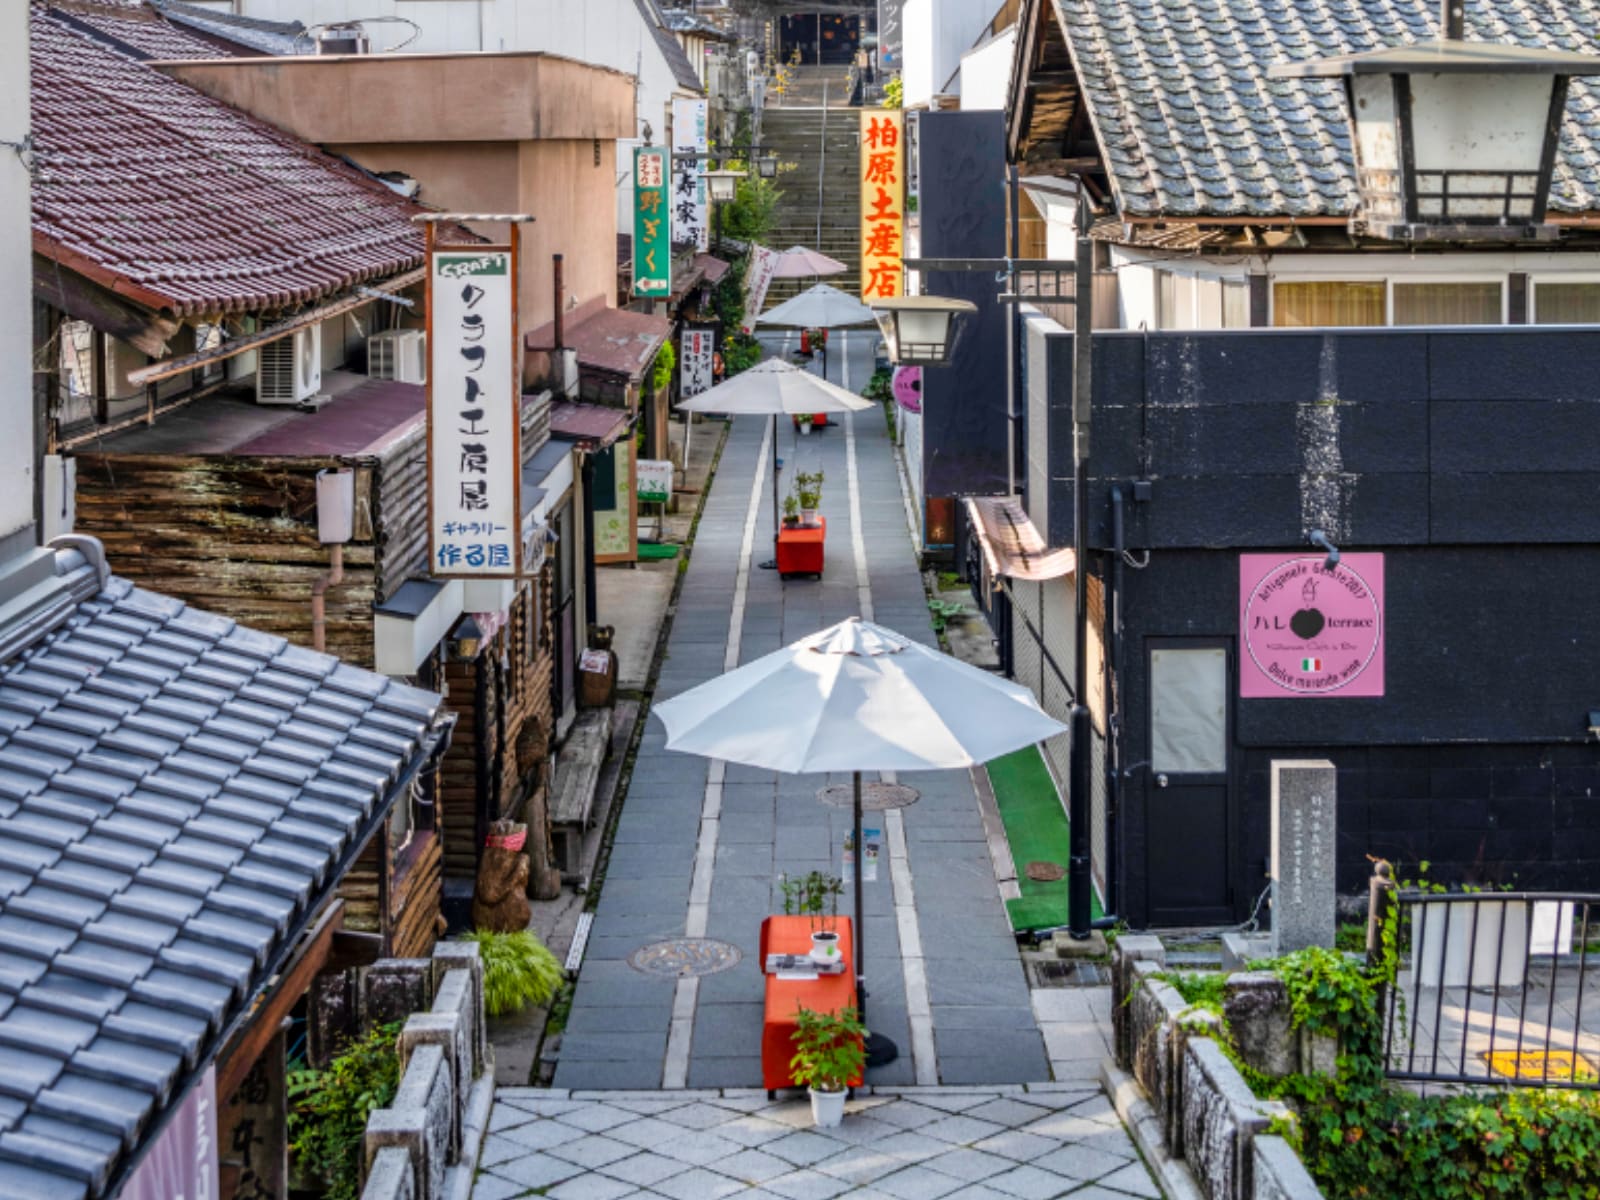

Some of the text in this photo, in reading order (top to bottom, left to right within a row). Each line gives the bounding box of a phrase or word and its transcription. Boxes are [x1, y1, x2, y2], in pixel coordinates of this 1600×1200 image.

[882, 0, 899, 35] ック
[863, 116, 901, 298] 柏原土産店
[639, 190, 663, 273] 野ぎく
[440, 254, 504, 279] CRAFT
[442, 521, 507, 537] ギャラリー
[437, 543, 511, 567] 作る屋
[1328, 616, 1374, 629] terrace
[1268, 661, 1294, 684] Dolce
